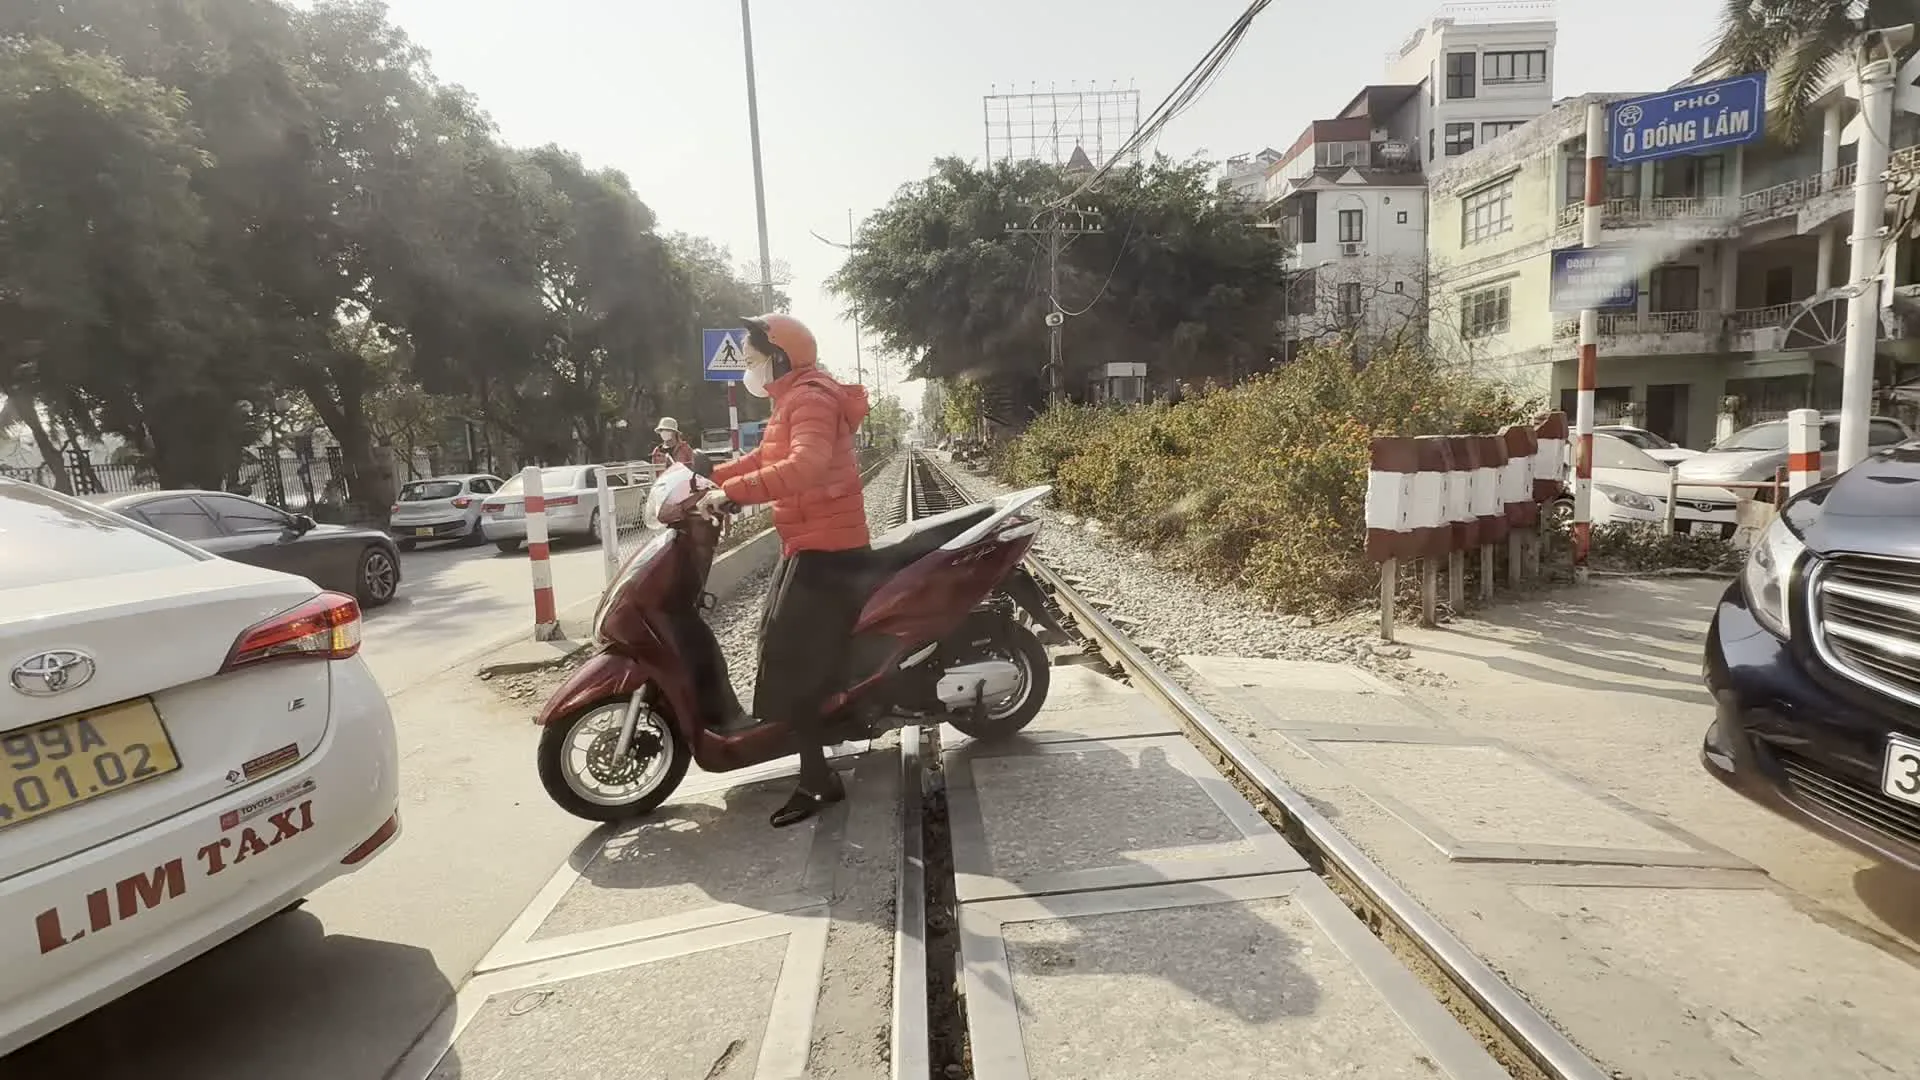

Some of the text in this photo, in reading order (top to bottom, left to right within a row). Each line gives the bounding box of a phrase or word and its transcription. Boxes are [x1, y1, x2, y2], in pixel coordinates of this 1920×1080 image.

[1674, 88, 1720, 112] PHỐ
[1623, 128, 1635, 153] Ô
[2, 718, 107, 770] 99A
[1895, 754, 1920, 794] 3
[242, 796, 273, 815] TOYOTA
[36, 800, 315, 954] LIM TAXI
